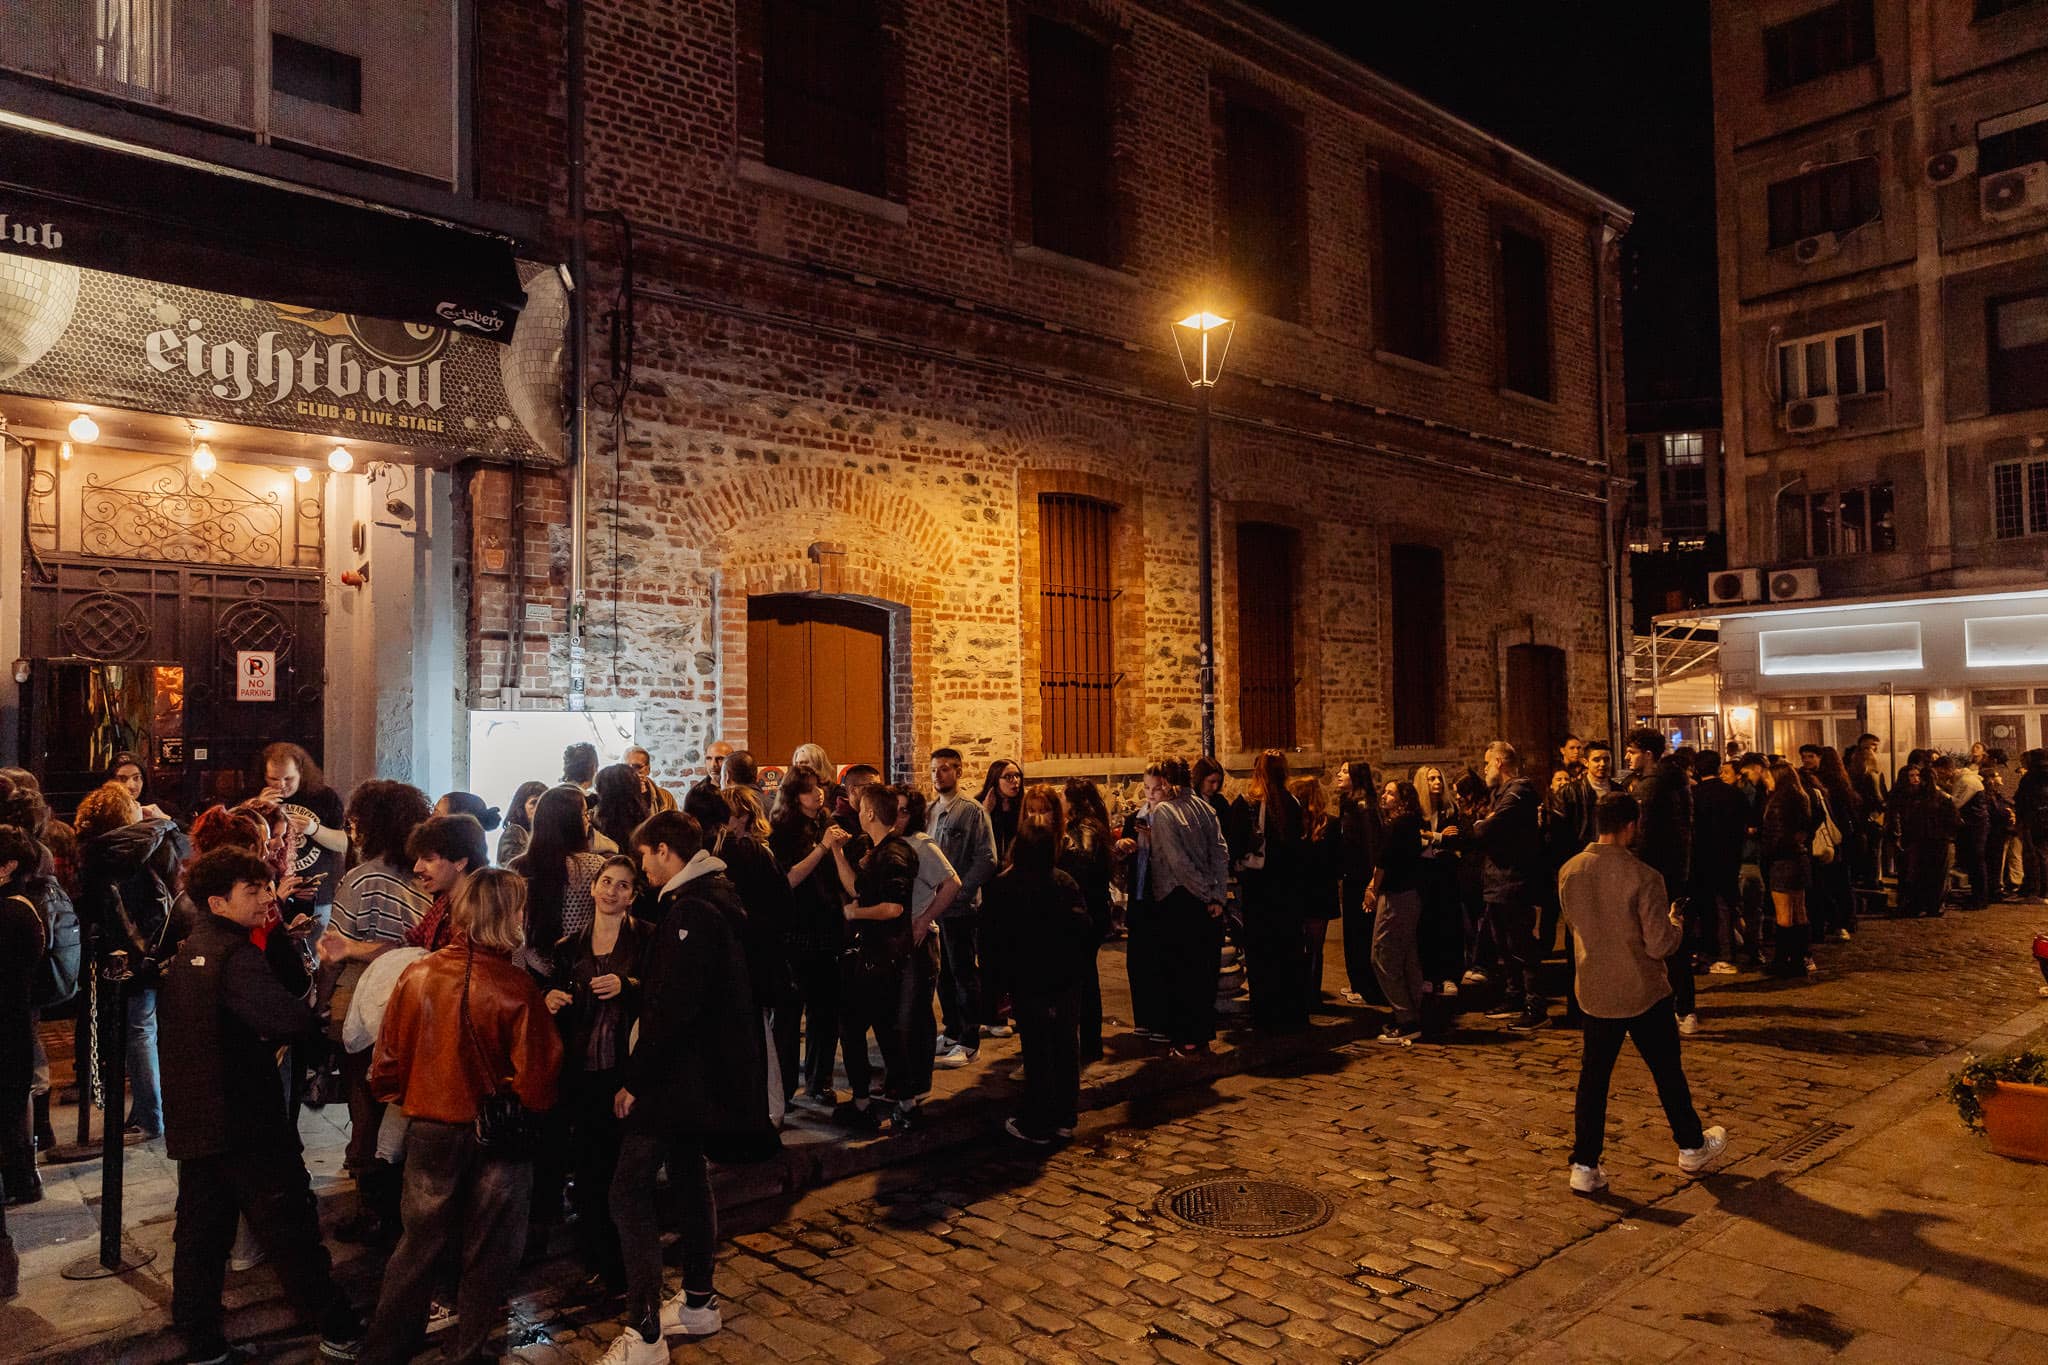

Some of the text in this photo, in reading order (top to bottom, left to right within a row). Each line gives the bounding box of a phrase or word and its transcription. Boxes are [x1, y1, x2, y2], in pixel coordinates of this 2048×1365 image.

[435, 302, 504, 330] Carlsberg
[145, 318, 448, 412] eightball
[297, 401, 445, 433] CLUB & LIVE STAGE
[241, 689, 272, 697] PARKING
[248, 679, 265, 688] NO
